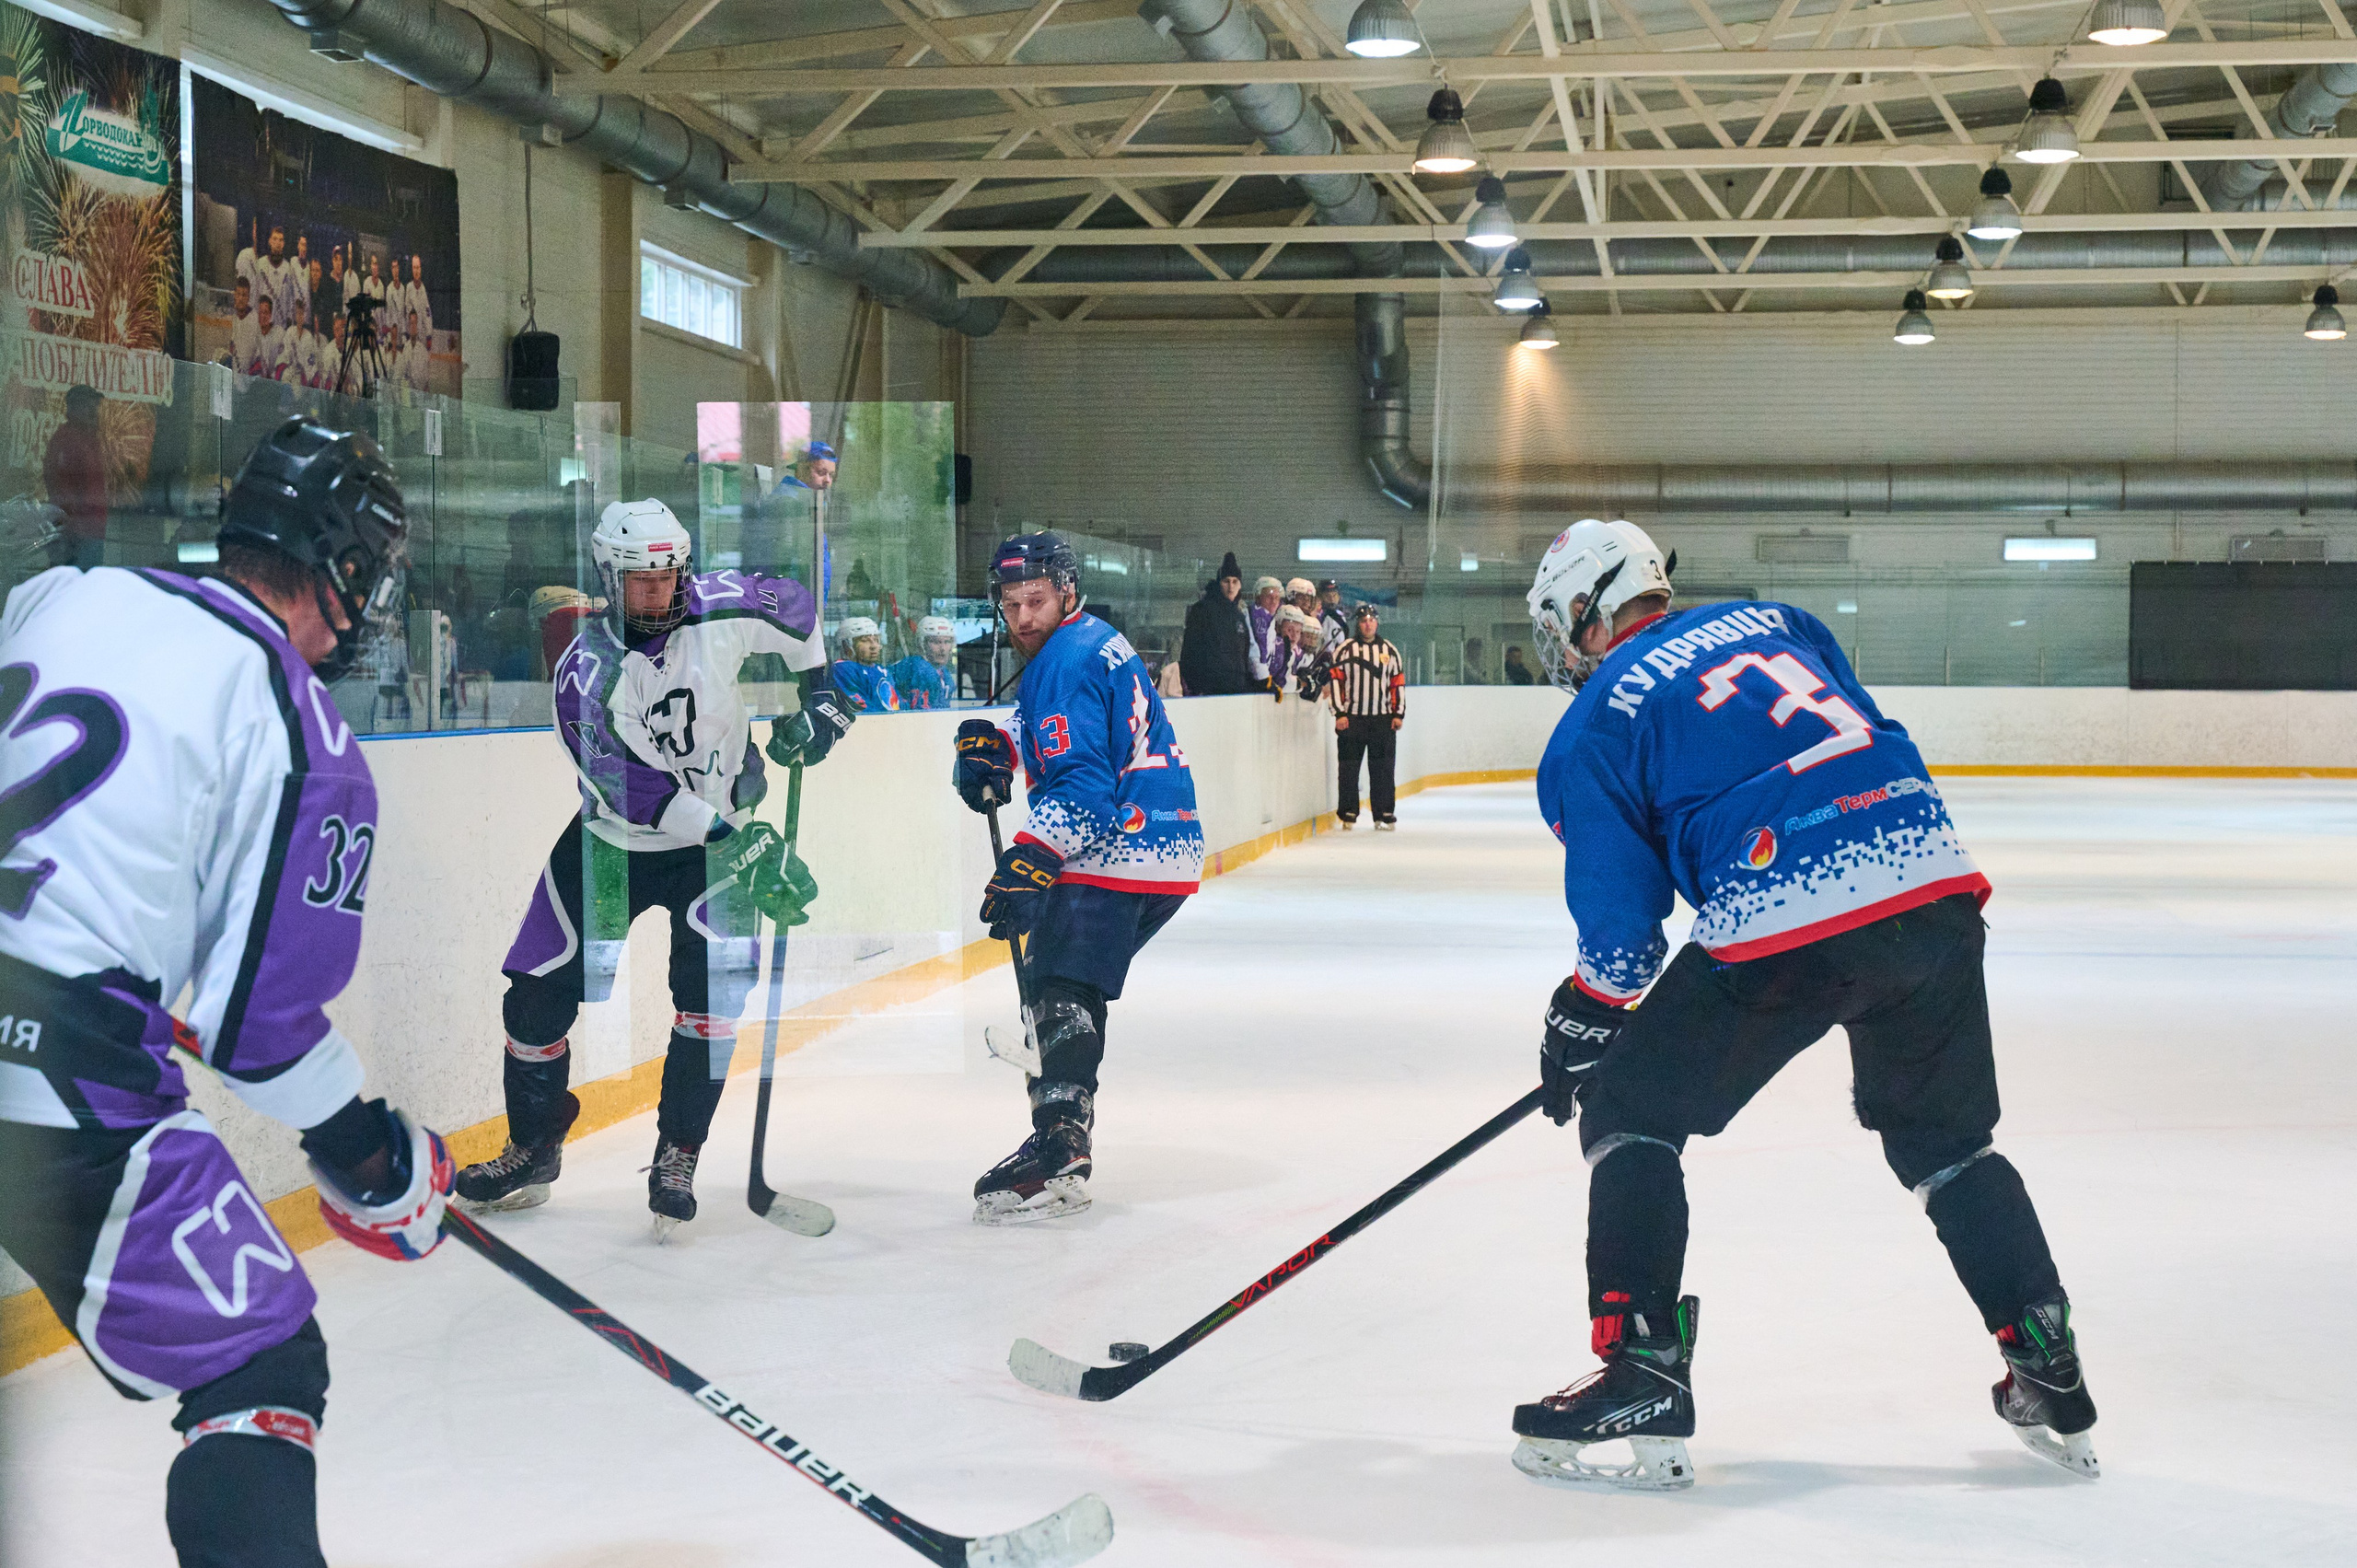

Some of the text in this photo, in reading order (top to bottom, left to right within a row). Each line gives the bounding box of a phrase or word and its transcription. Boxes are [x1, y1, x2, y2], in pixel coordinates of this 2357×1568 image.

[14, 254, 92, 310] СЛАВА
[1649, 558, 1663, 581] 3
[909, 689, 931, 710] 71
[1696, 651, 1874, 776] 3
[302, 814, 376, 916] 32
[1228, 1233, 1340, 1308] VAPOR
[1615, 1396, 1673, 1433] CCM
